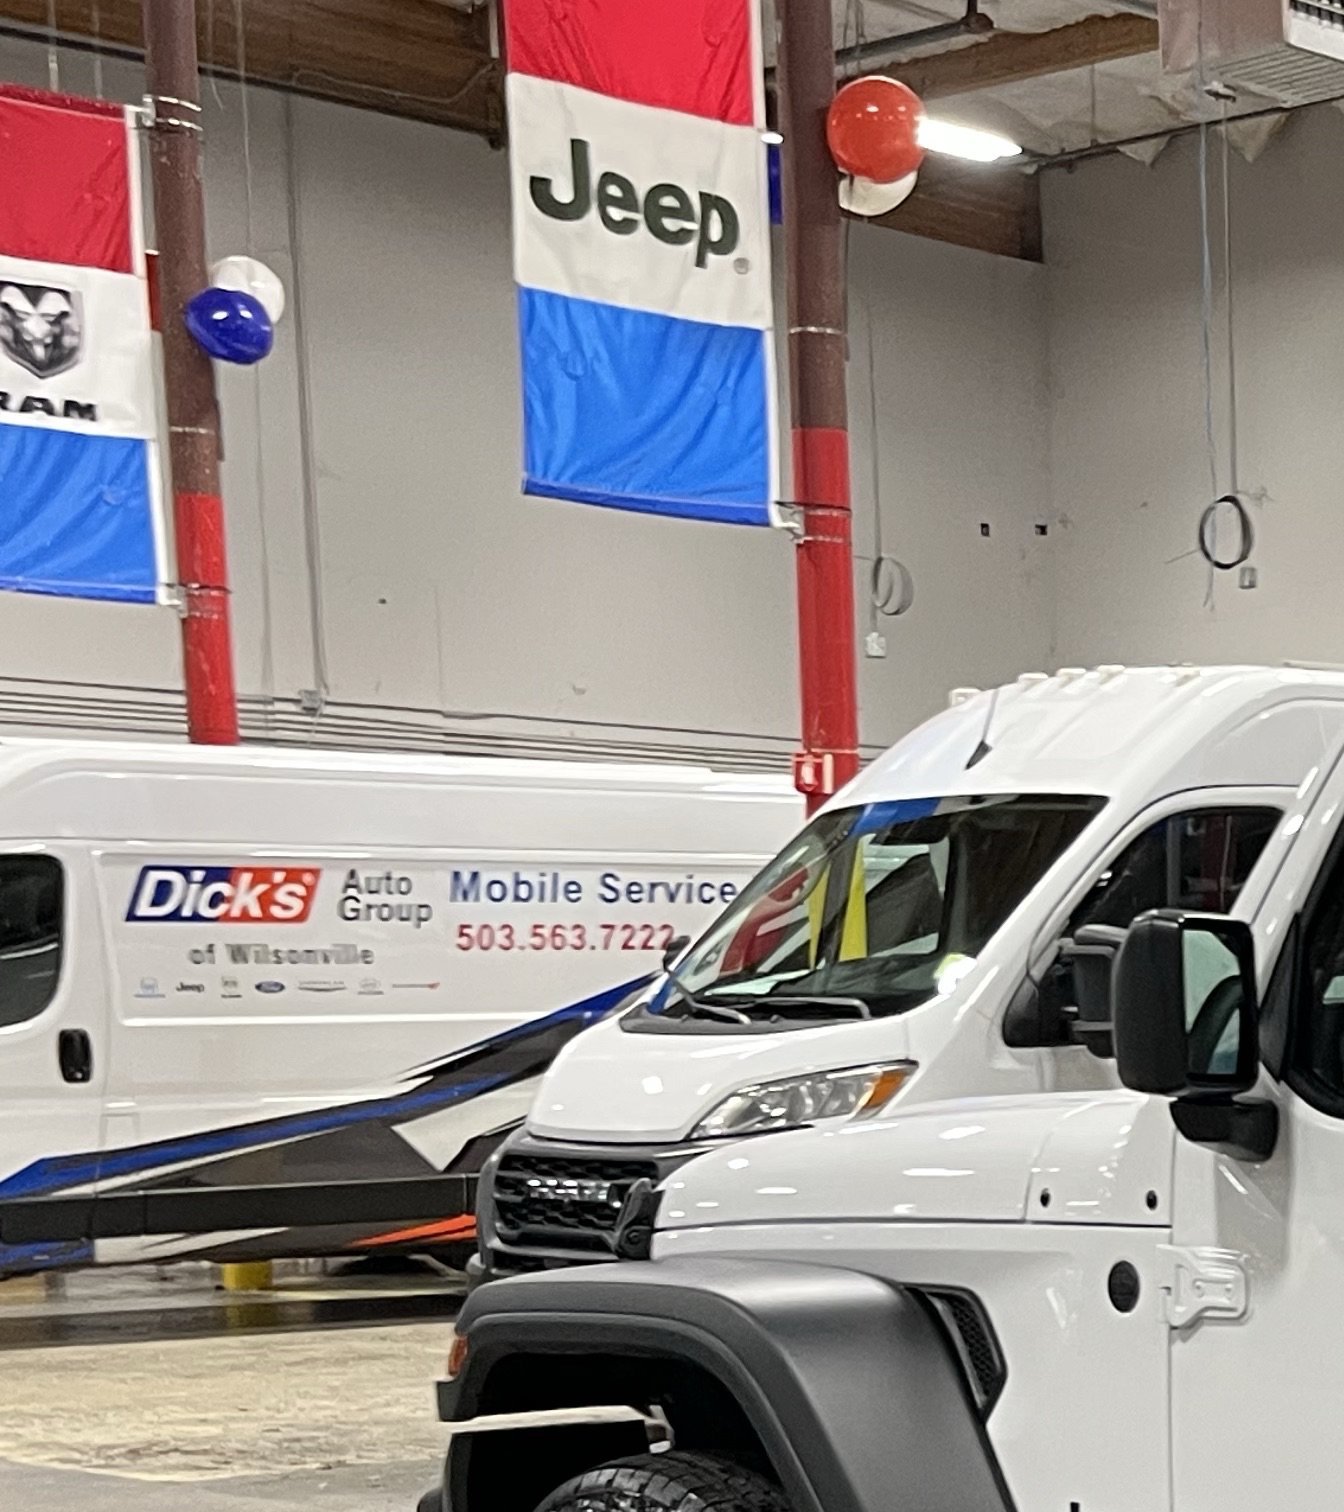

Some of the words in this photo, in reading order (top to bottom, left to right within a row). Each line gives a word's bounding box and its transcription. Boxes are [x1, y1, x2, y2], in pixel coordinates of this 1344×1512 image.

[529, 138, 741, 269] Jeep
[341, 868, 413, 895] Auto
[451, 870, 583, 903] Mobile
[599, 872, 738, 904] Service
[337, 895, 433, 929] Group
[456, 923, 675, 951] 503.563.7222
[188, 942, 216, 965] of
[225, 943, 375, 965] Wilsonville
